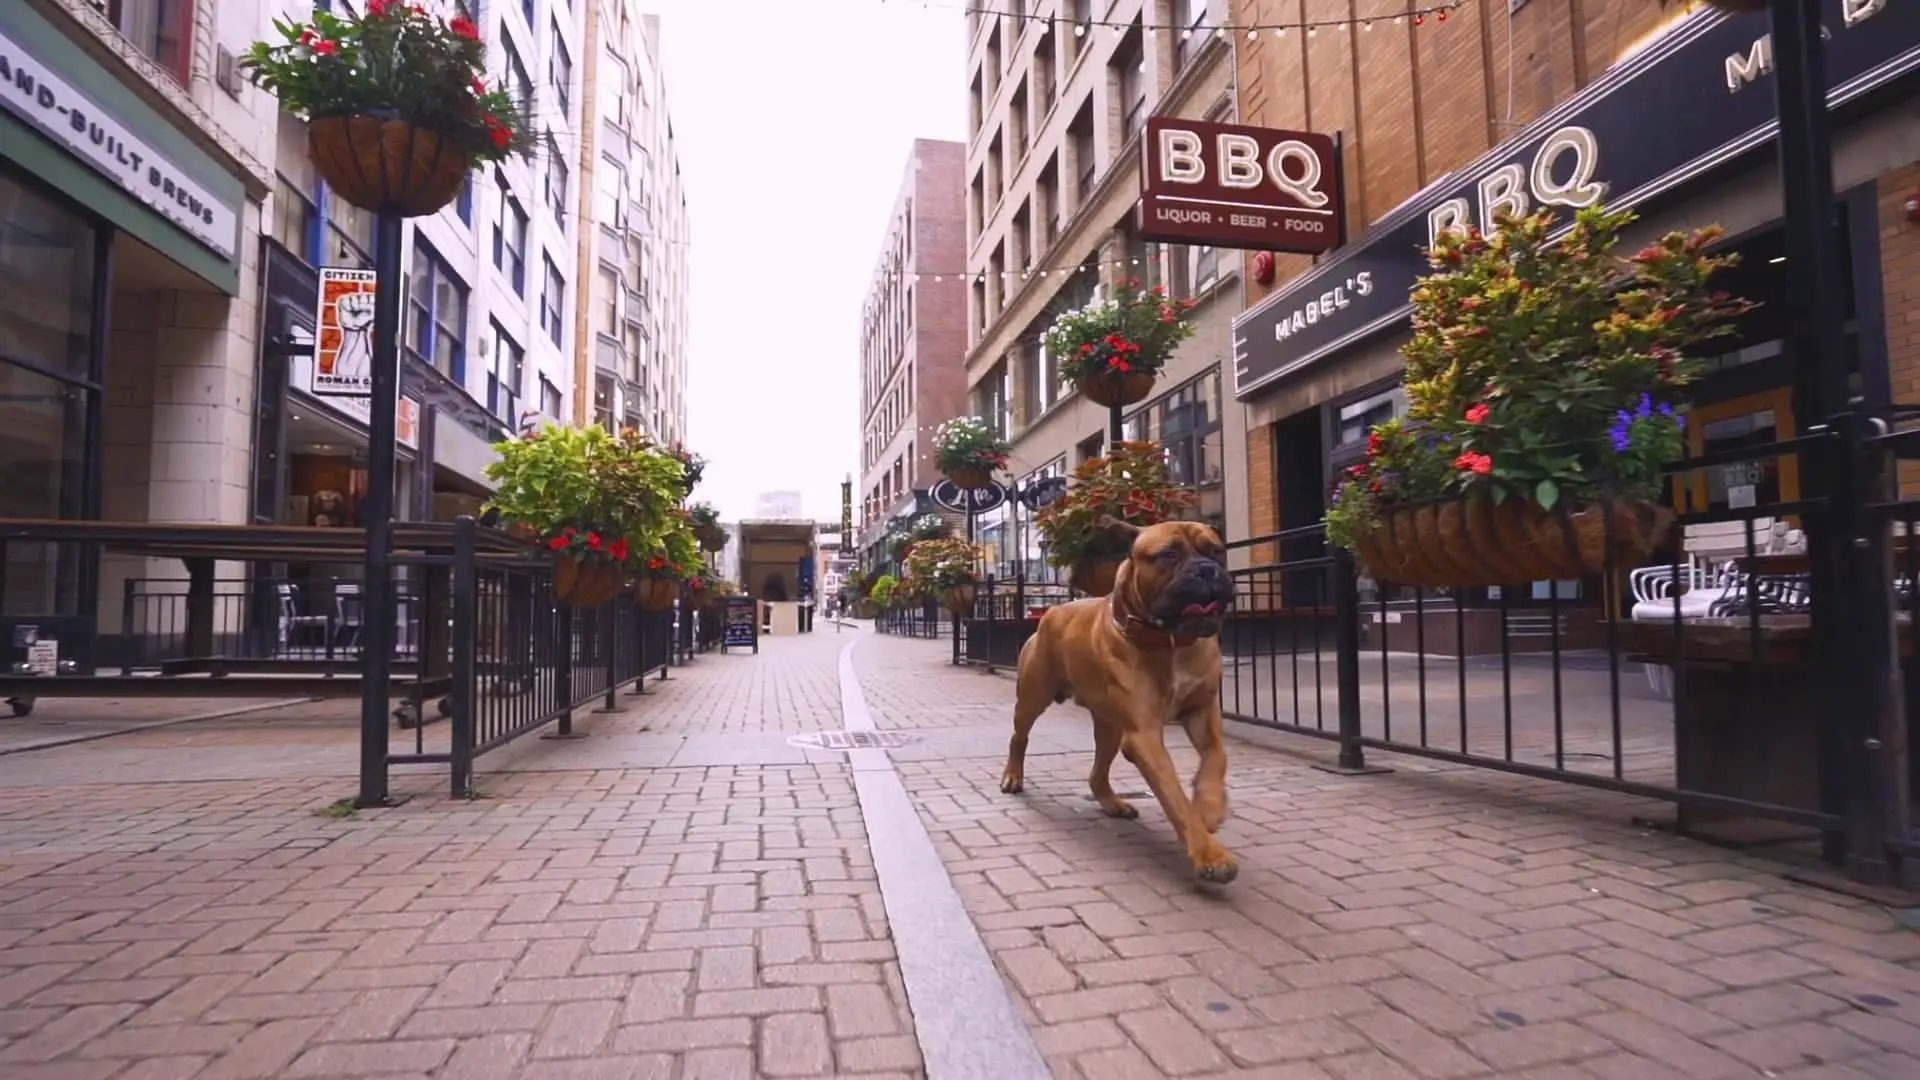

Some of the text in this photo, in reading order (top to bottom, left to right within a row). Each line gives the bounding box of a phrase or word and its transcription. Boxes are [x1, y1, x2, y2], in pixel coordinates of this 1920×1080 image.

[1158, 128, 1330, 209] BBQ
[149, 166, 214, 225] BREWS
[1156, 207, 1325, 234] LIQUOR BEER FOOD
[1274, 271, 1374, 342] MABEL'S
[1428, 126, 1608, 252] BBQ
[324, 271, 374, 281] CITIZEN
[316, 375, 360, 385] ROMAN
